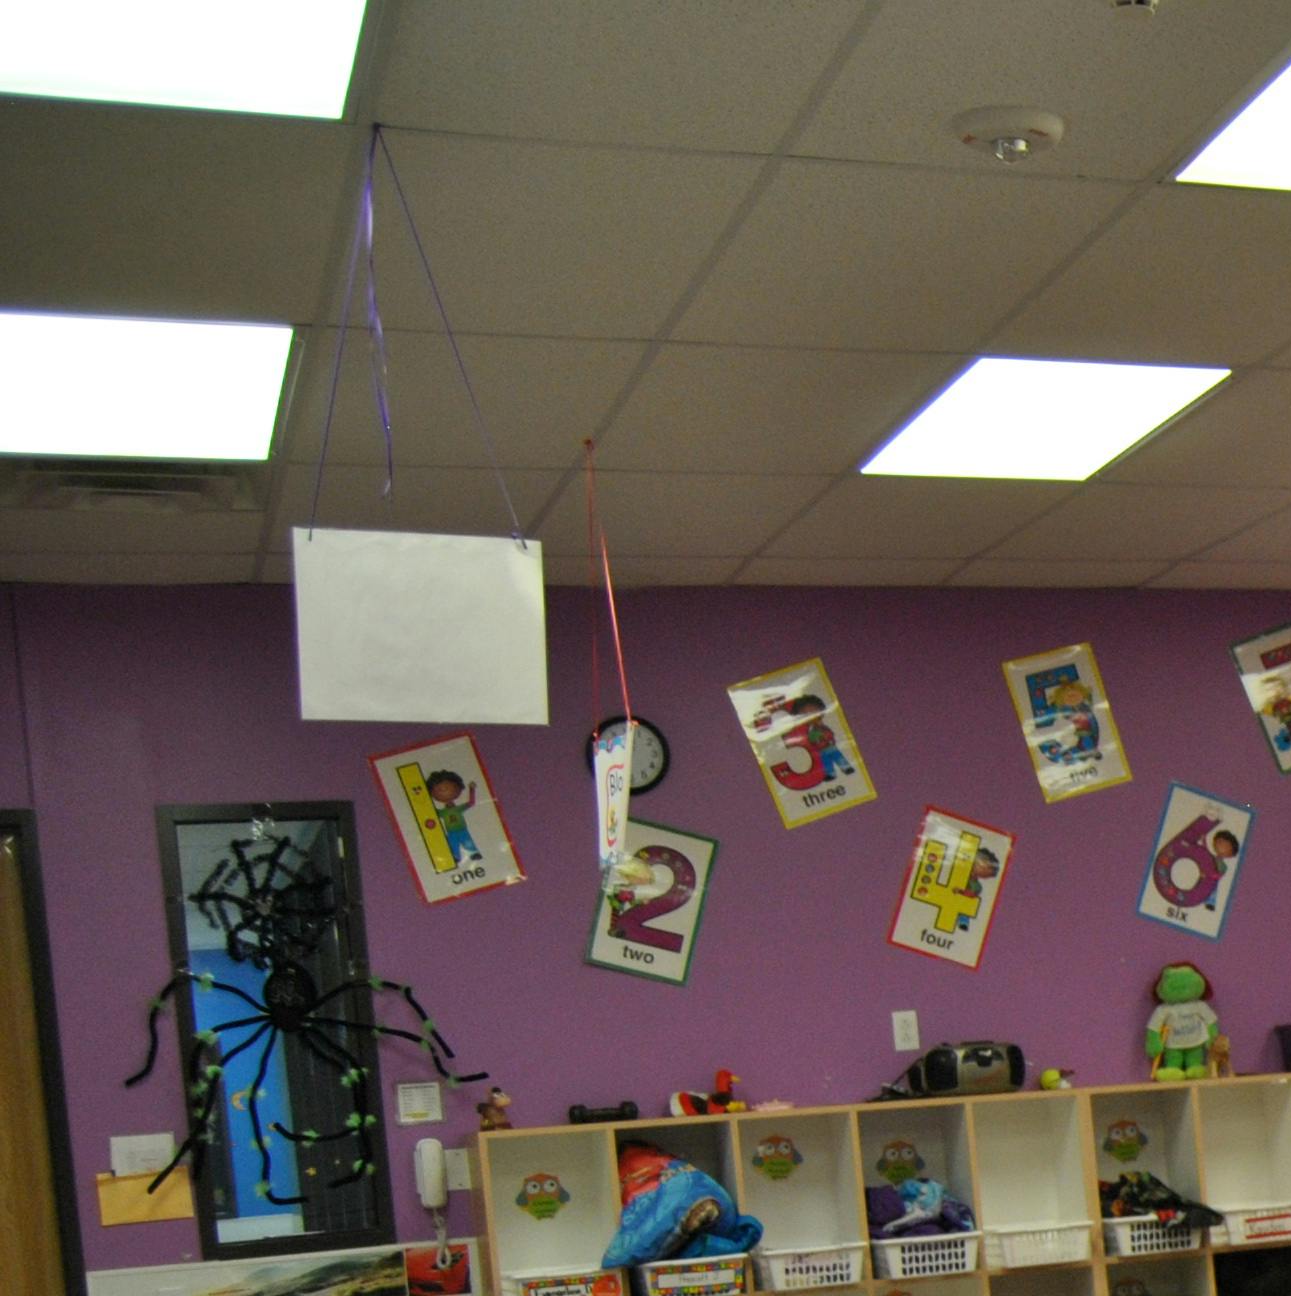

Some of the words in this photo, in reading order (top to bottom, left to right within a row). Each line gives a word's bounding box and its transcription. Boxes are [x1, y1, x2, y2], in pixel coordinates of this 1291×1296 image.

[802, 781, 848, 811] three
[452, 866, 486, 885] one
[1166, 904, 1189, 925] six
[920, 928, 956, 953] four
[622, 943, 656, 966] two
